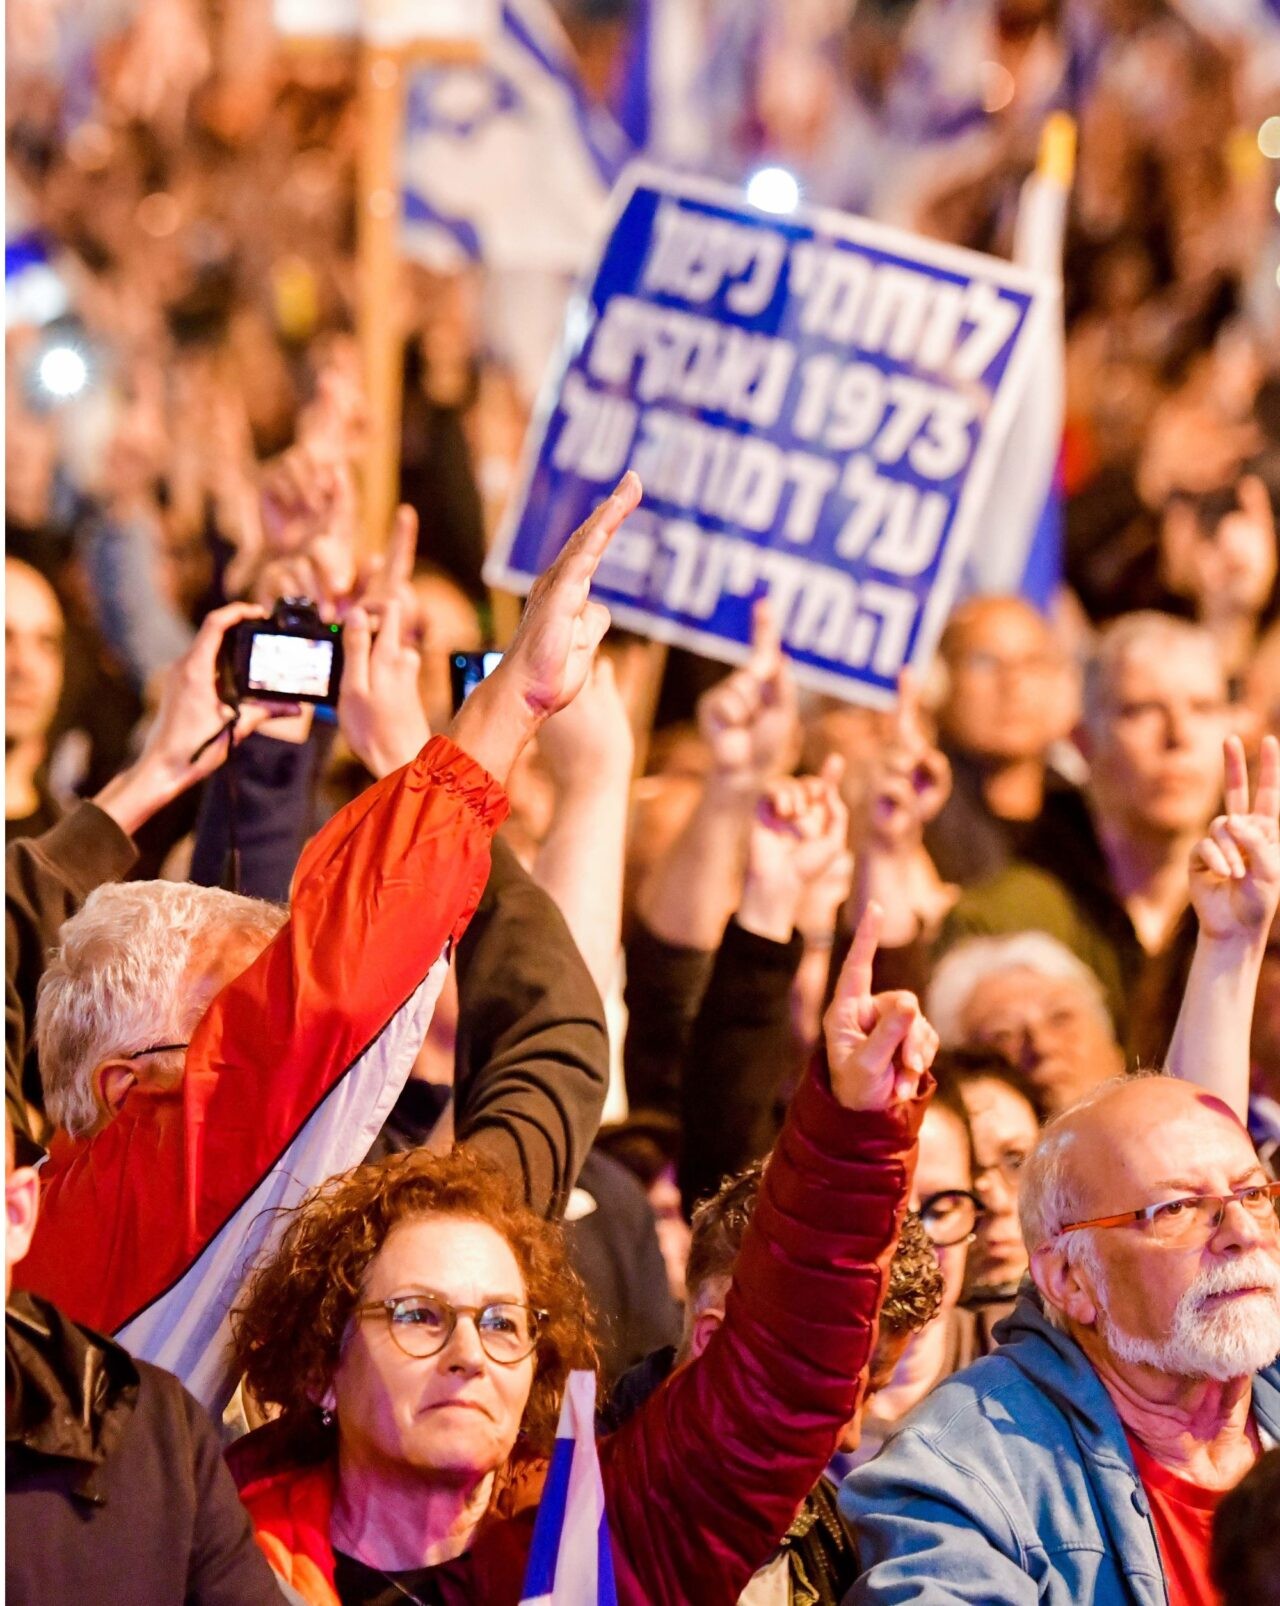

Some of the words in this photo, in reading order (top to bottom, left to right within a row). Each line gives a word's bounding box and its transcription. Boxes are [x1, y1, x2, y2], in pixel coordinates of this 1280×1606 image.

[787, 241, 1020, 375] לוחמי
[552, 372, 634, 479] של
[792, 355, 975, 479] 1973
[834, 457, 949, 574] על
